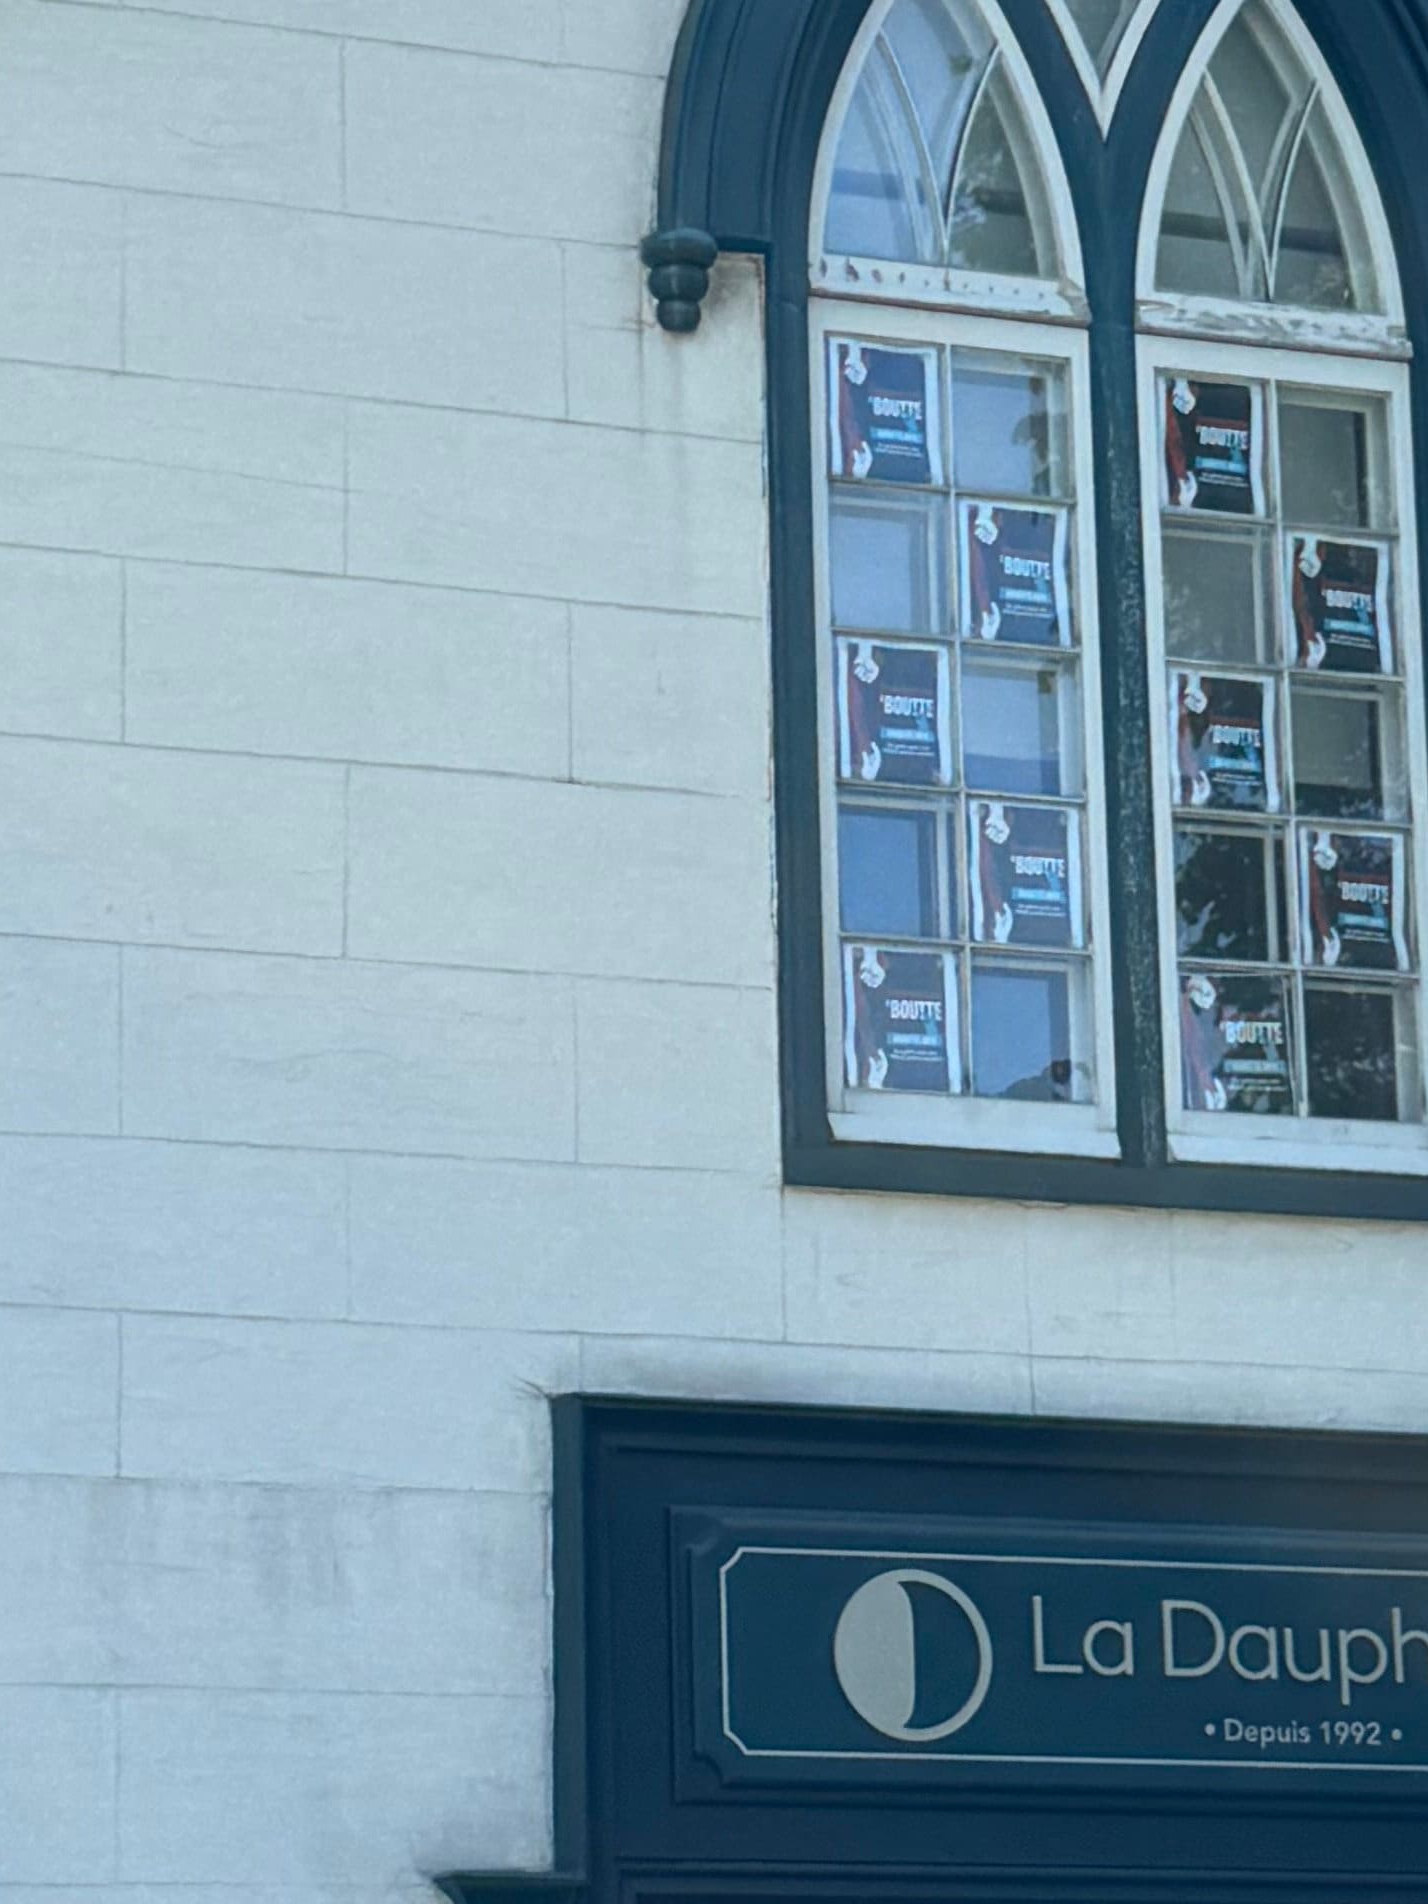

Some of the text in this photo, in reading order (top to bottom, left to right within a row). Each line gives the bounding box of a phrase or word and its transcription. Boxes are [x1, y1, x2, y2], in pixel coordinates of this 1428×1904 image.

[1031, 1595, 1134, 1676] La
[1223, 1719, 1381, 1747] Depuis 1992
